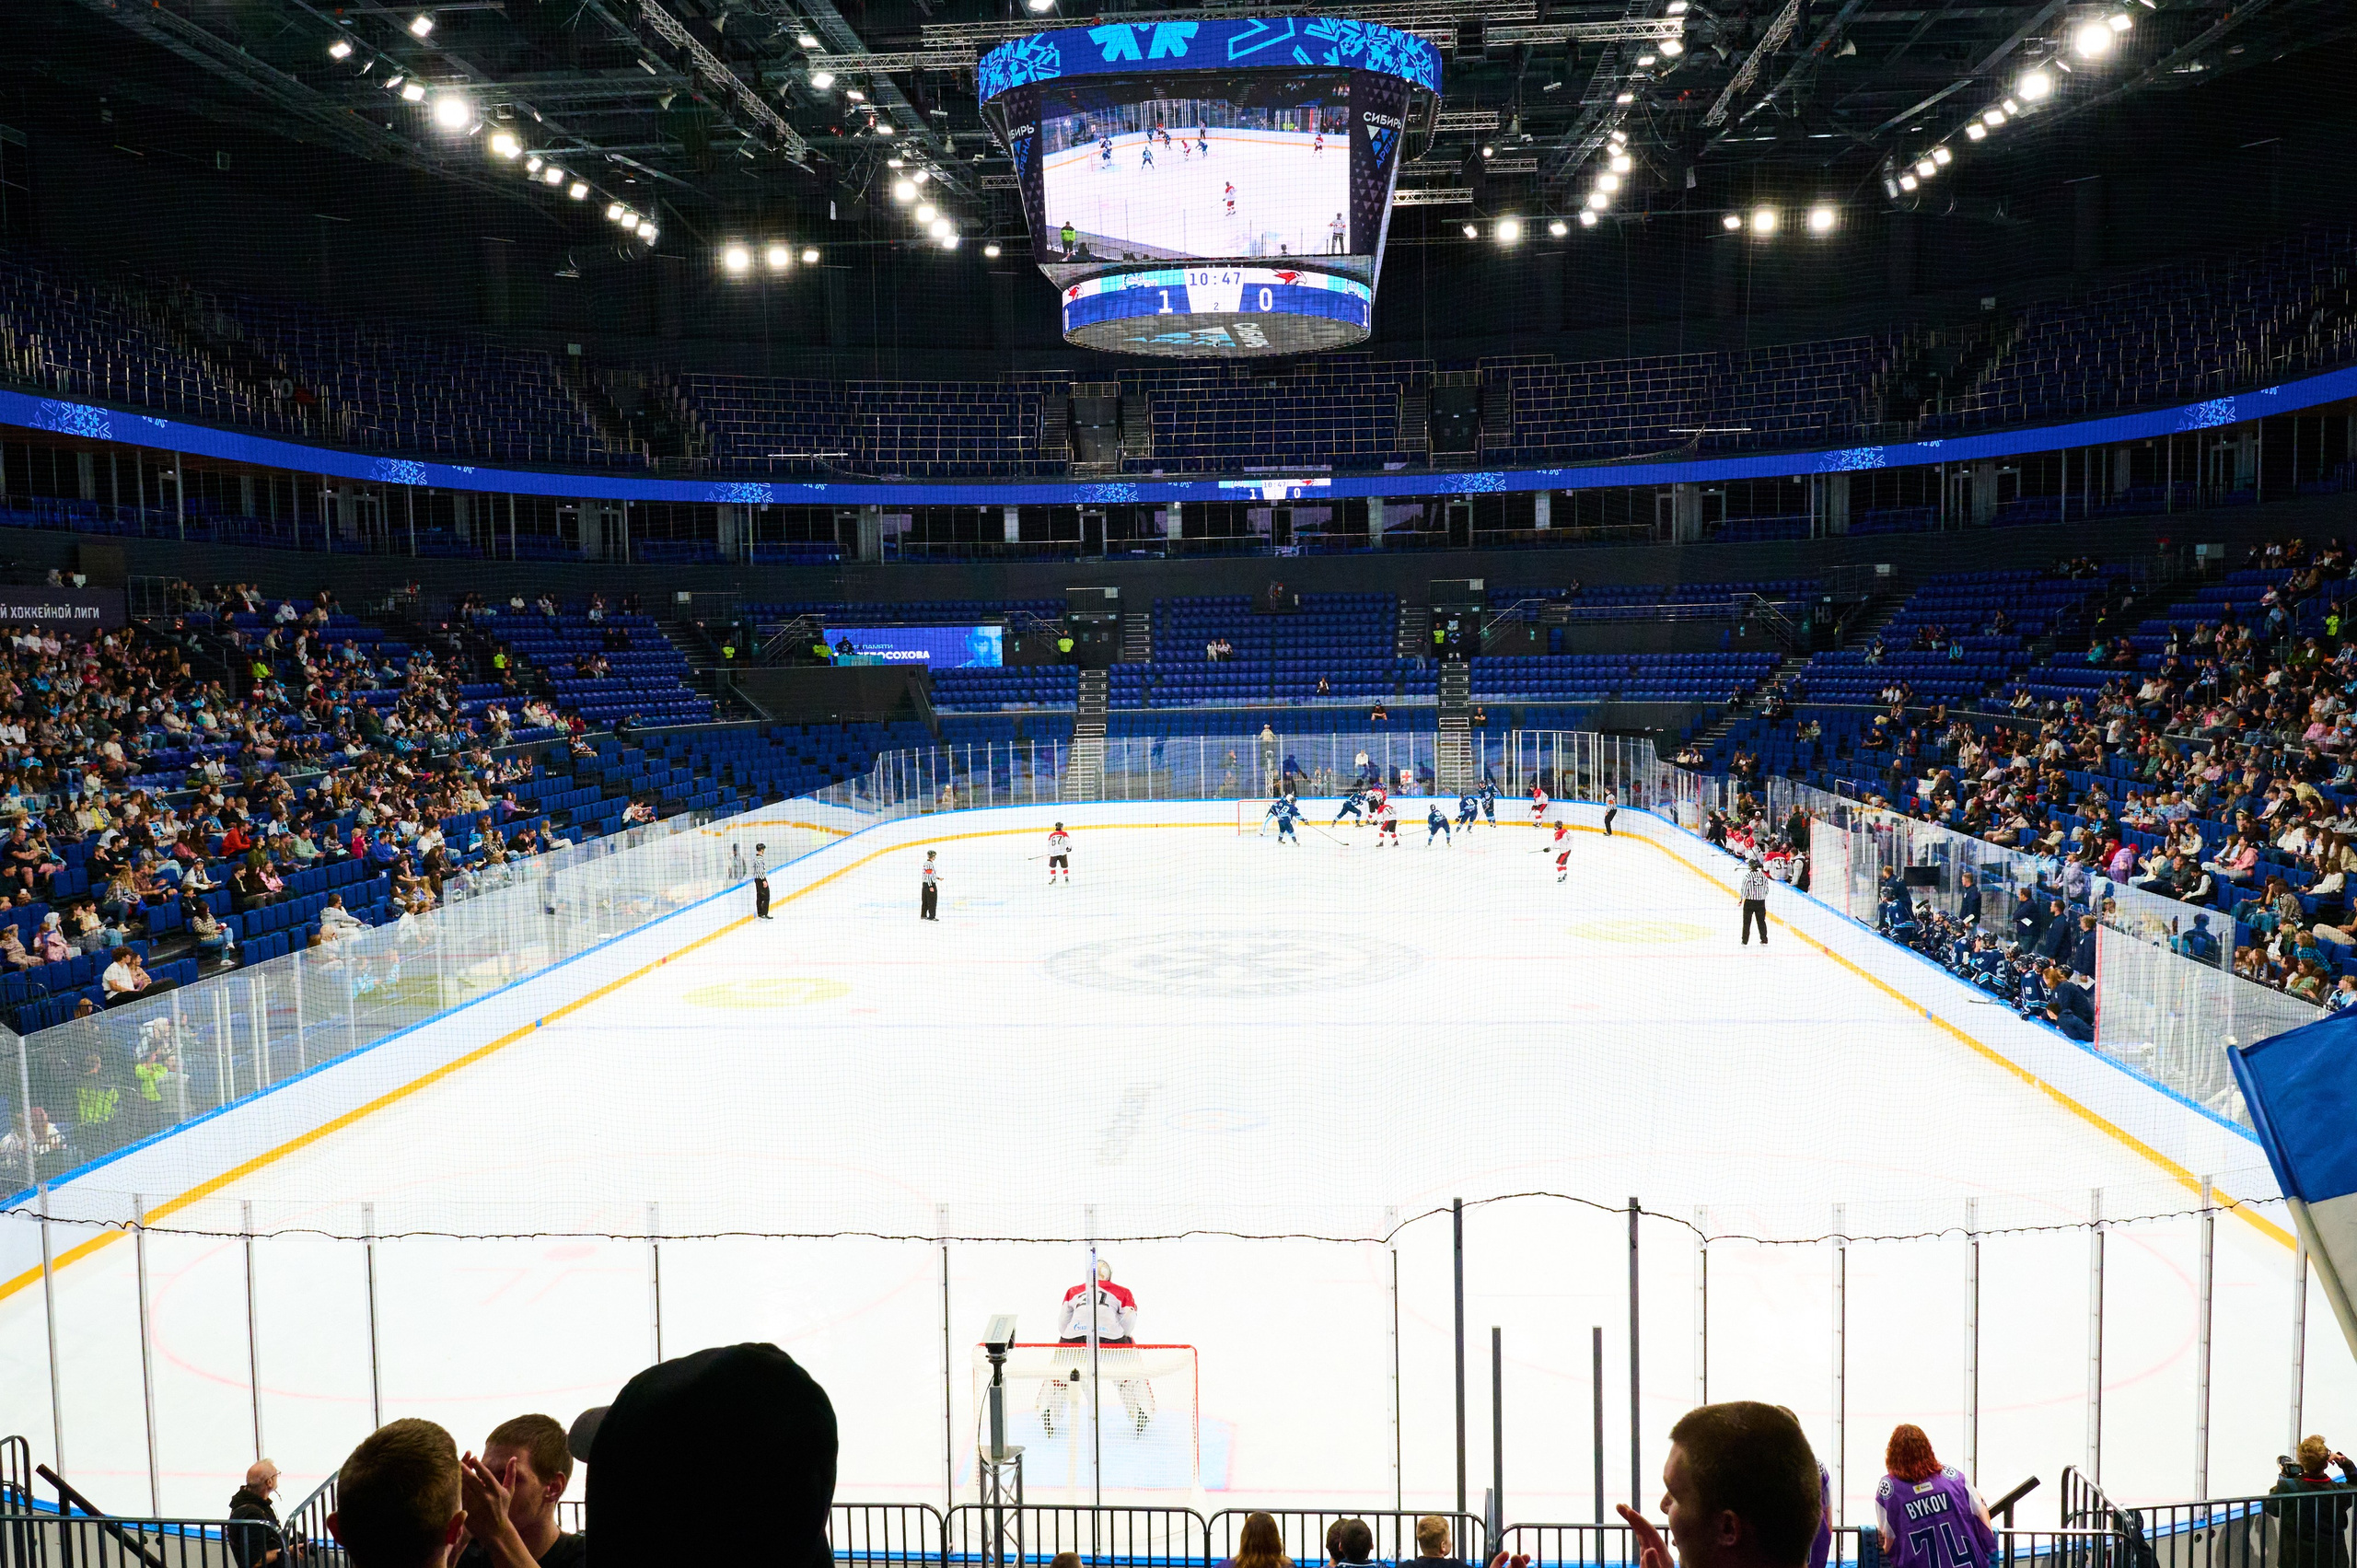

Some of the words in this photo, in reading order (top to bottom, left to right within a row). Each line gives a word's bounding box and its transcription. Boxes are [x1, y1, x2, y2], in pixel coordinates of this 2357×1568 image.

[1363, 111, 1402, 129] СИБИРЬ
[1010, 124, 1035, 140] БИРЬ
[1189, 272, 1241, 286] 10:47
[1158, 290, 1173, 314] 1
[1213, 302, 1219, 310] 2
[1259, 287, 1273, 311] 0
[1249, 489, 1257, 500] 1
[1294, 488, 1301, 498] 0
[10, 603, 72, 619] ХОККЕЙНОЙ
[74, 607, 100, 619] ЛИГИ
[1051, 835, 1062, 846] 67
[1905, 1493, 1948, 1520] BYKOV
